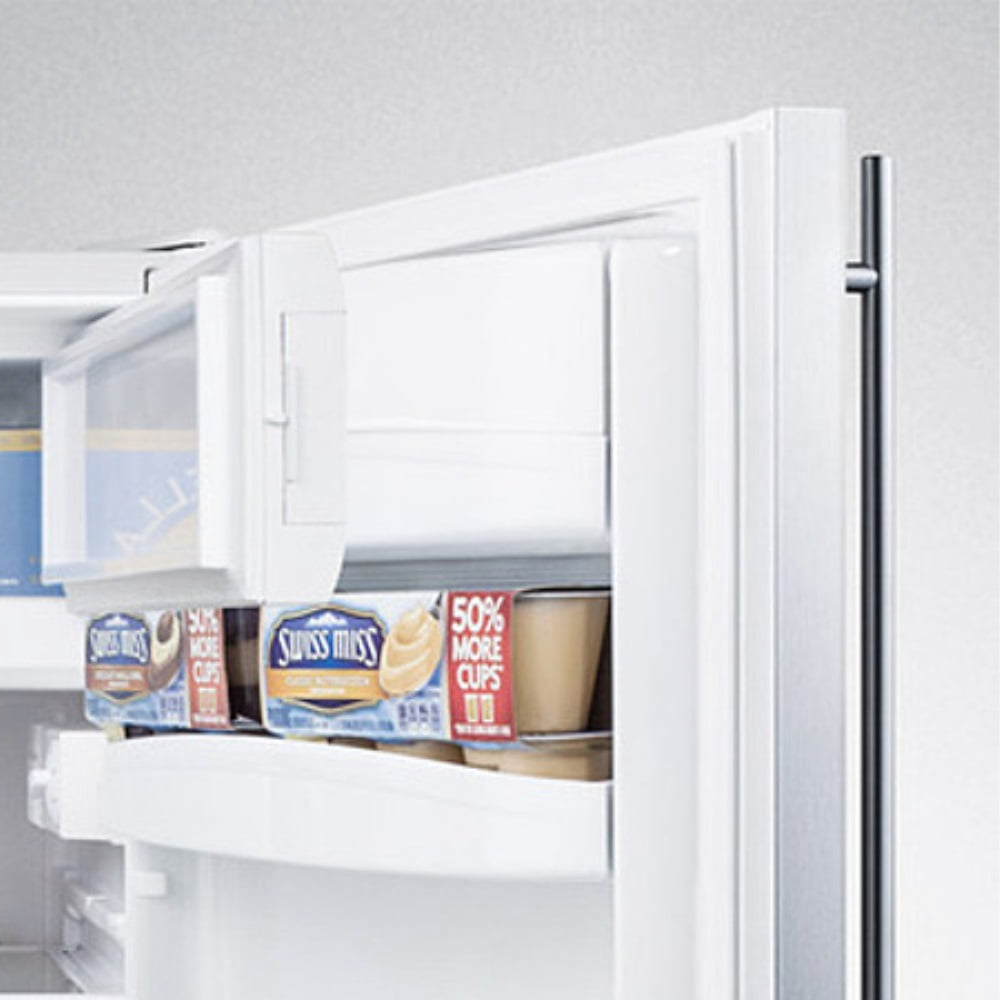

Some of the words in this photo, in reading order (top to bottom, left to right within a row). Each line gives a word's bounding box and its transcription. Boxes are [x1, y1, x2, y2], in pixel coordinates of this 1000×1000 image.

[451, 596, 505, 632] 50%
[278, 627, 329, 667] SWISS
[332, 627, 378, 667] MISS
[452, 636, 503, 663] MORE
